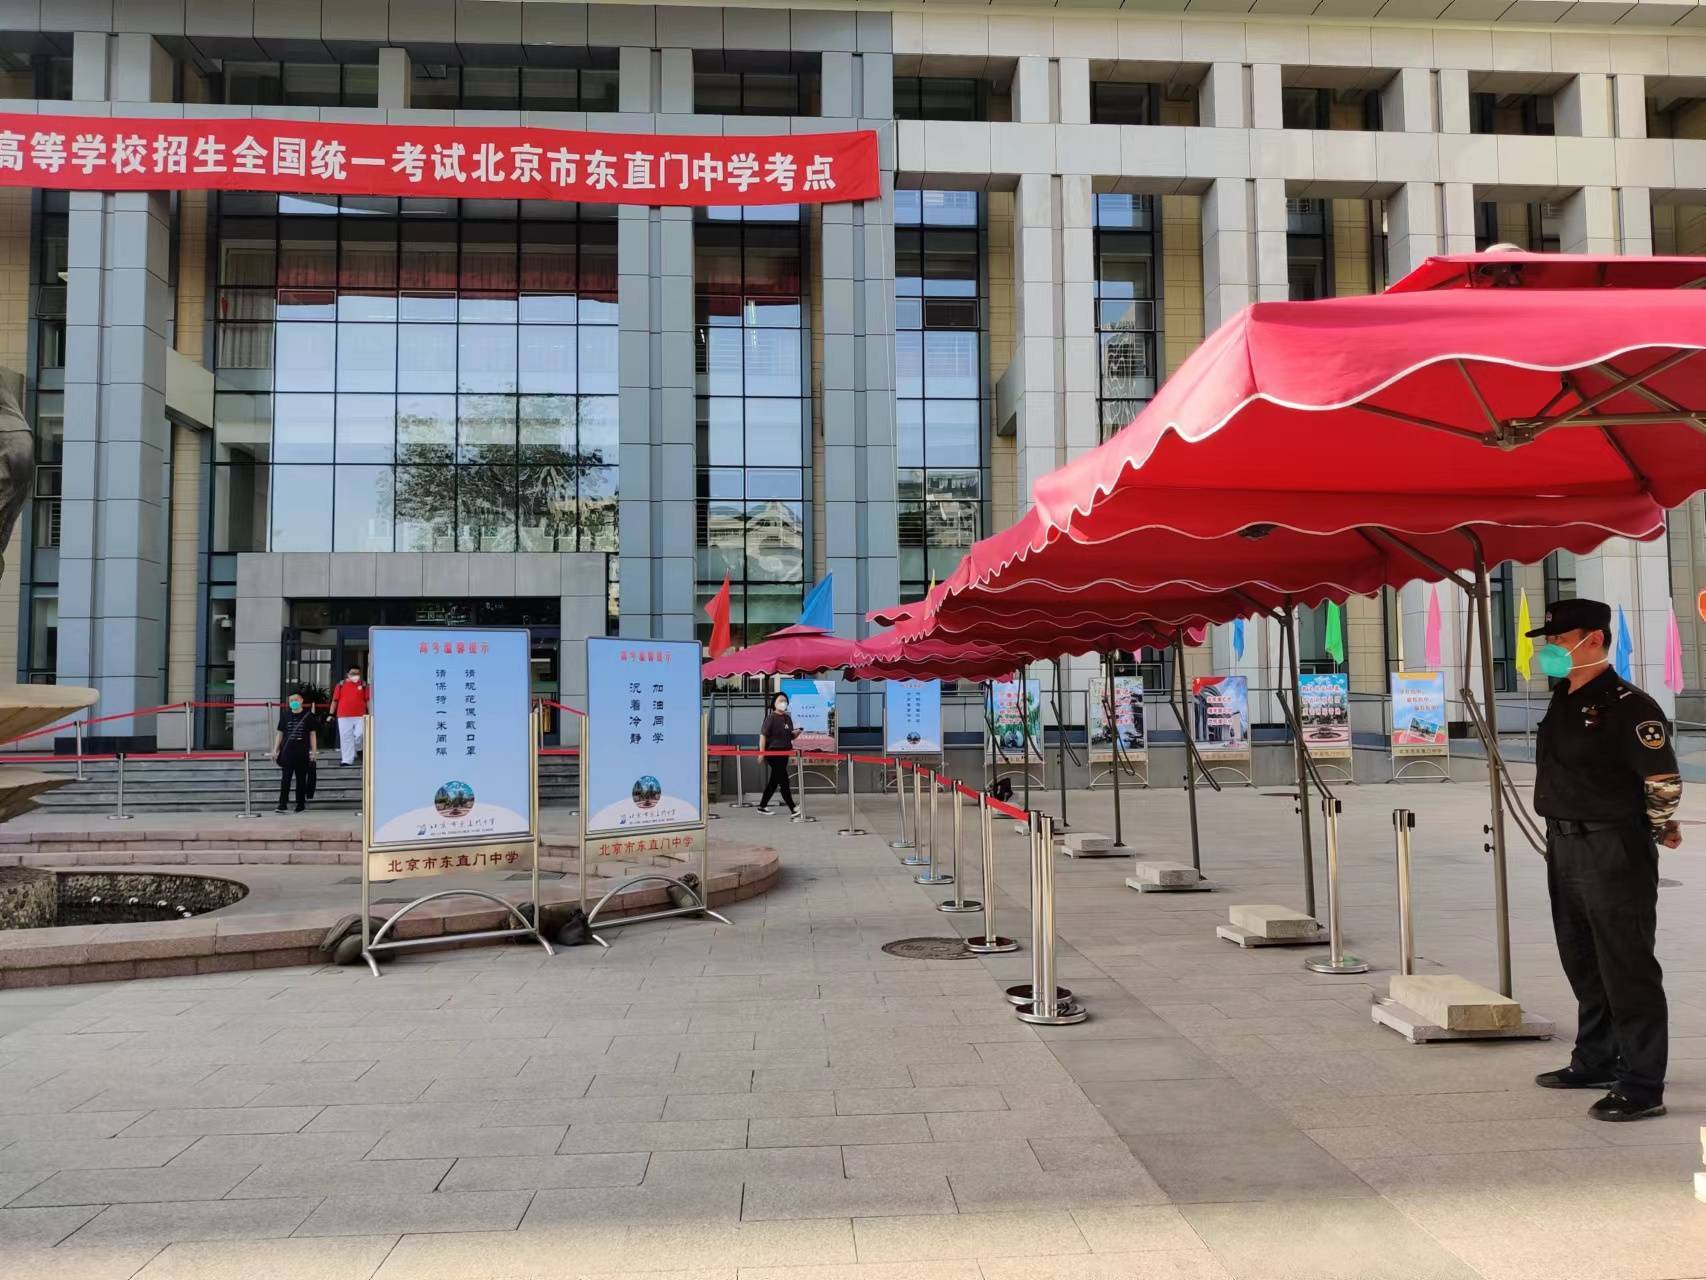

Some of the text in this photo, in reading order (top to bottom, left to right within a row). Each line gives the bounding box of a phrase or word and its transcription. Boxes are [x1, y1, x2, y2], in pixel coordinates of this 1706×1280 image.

[0, 130, 836, 192] 高等学校招生全国统一考试北京市东直门中学考点
[629, 682, 642, 744] 沉着冷静
[387, 850, 519, 874] 北京市东直门中学
[599, 834, 694, 857] 北京市东直门中学
